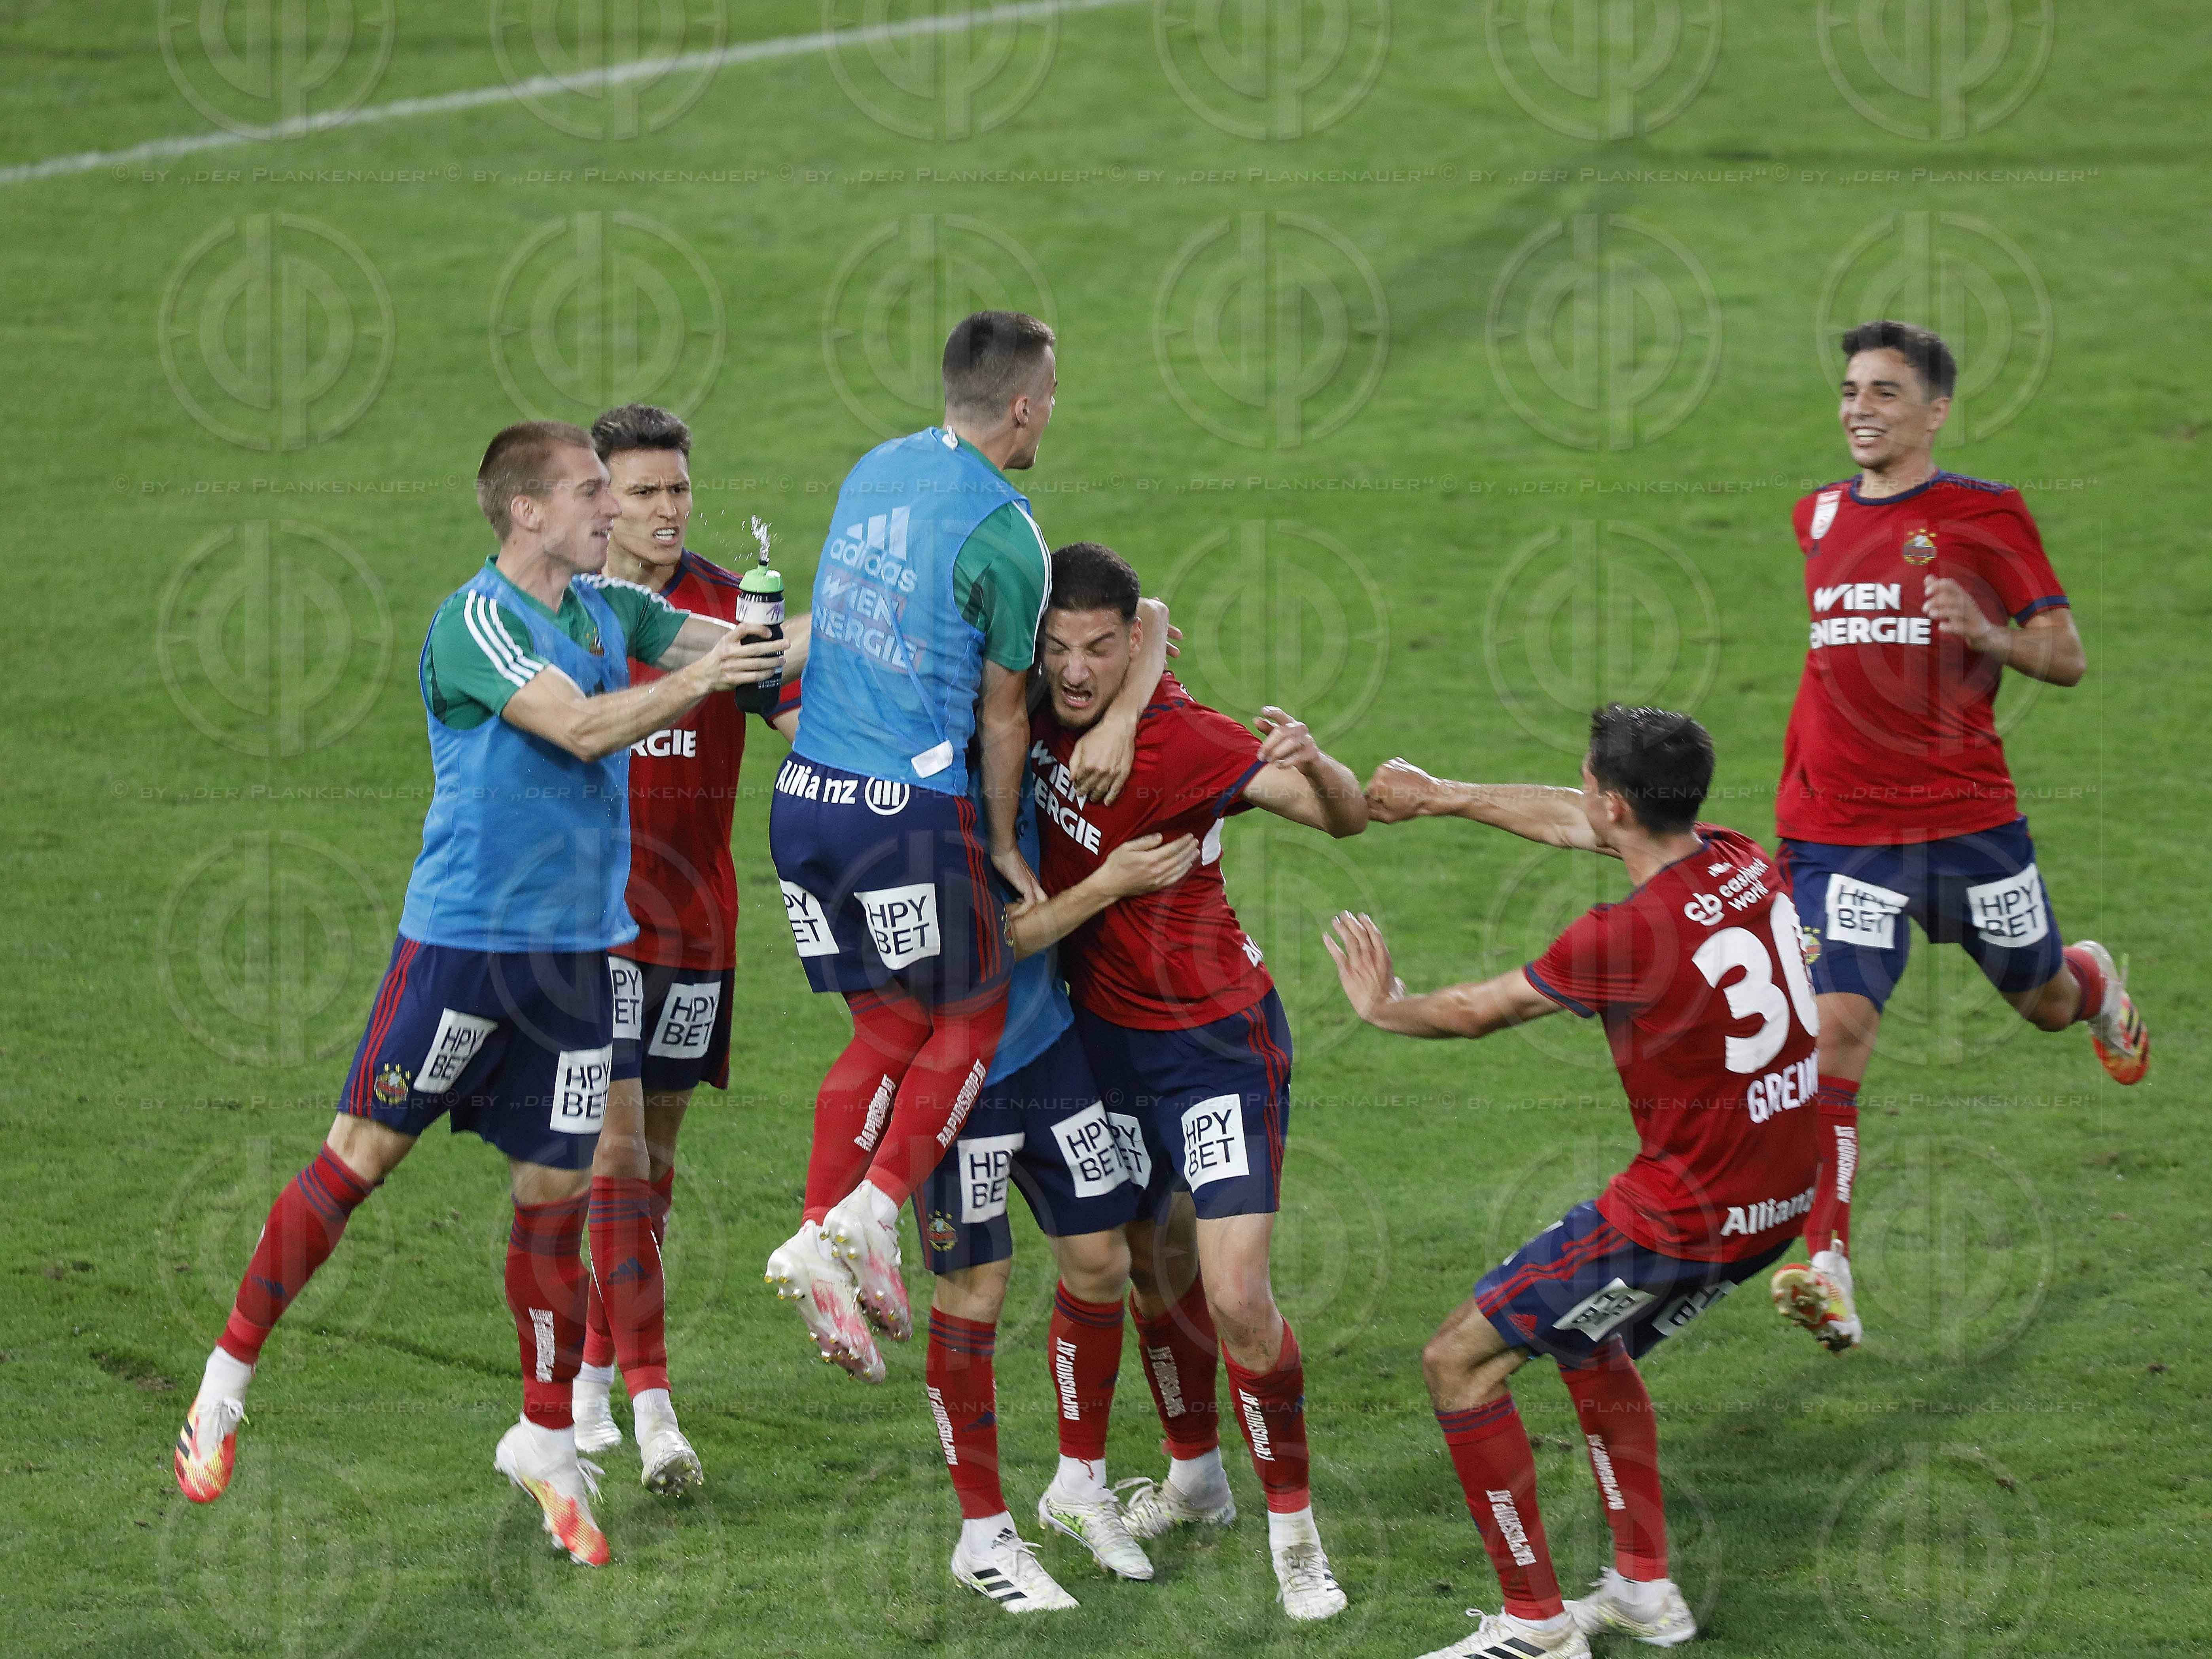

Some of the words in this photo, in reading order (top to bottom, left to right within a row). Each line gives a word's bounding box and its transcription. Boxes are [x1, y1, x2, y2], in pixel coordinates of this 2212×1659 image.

[830, 537, 918, 593] adidas
[1813, 582, 1902, 612] WIEN
[816, 601, 919, 669] NERGIE
[629, 728, 697, 758] RGIE
[775, 759, 858, 805] Allianz
[1032, 772, 1102, 856] ERGIE
[783, 892, 809, 917] PY
[867, 895, 927, 929] HPY
[1979, 879, 2035, 917] HPY
[790, 918, 821, 943] ET
[875, 923, 930, 956] BET
[612, 969, 640, 995] PY
[614, 998, 640, 1025] ET
[1110, 1123, 1136, 1148] PY
[1185, 1109, 1232, 1150] HPY
[969, 1149, 1013, 1180] HP
[1119, 1148, 1143, 1174] ET
[1188, 1136, 1235, 1178] BET
[972, 1179, 1005, 1209] BE
[1056, 1336, 1081, 1421] RAPIDSHOP.AT
[926, 1383, 959, 1466] RAPIDSHOP.AT
